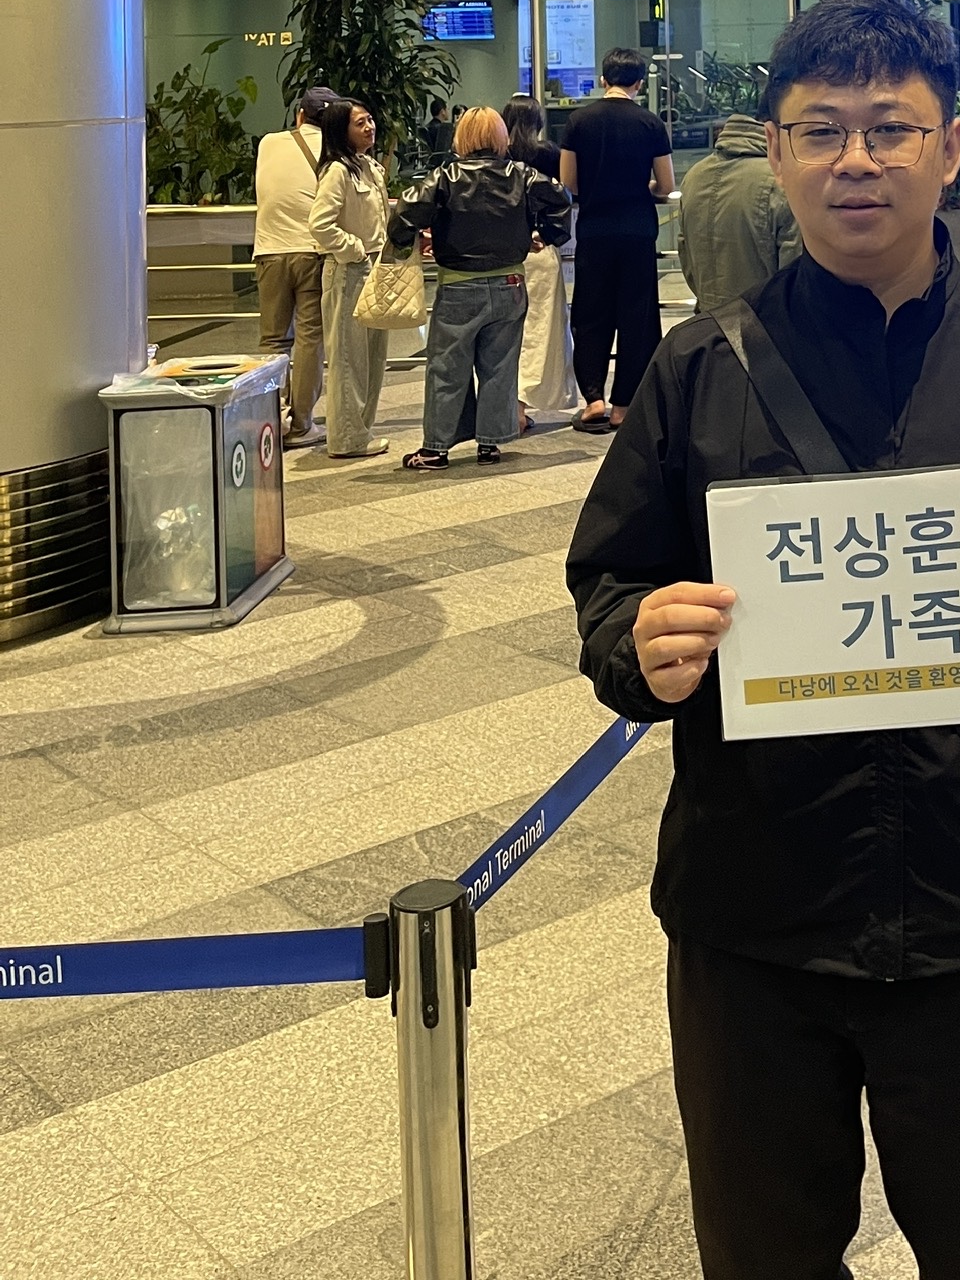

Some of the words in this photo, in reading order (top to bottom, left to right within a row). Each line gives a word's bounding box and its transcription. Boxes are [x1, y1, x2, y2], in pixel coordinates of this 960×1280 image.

[778, 677, 837, 700] 다낭에
[842, 673, 880, 694] 오신
[885, 669, 923, 692] 것을
[495, 809, 545, 875] Terminal
